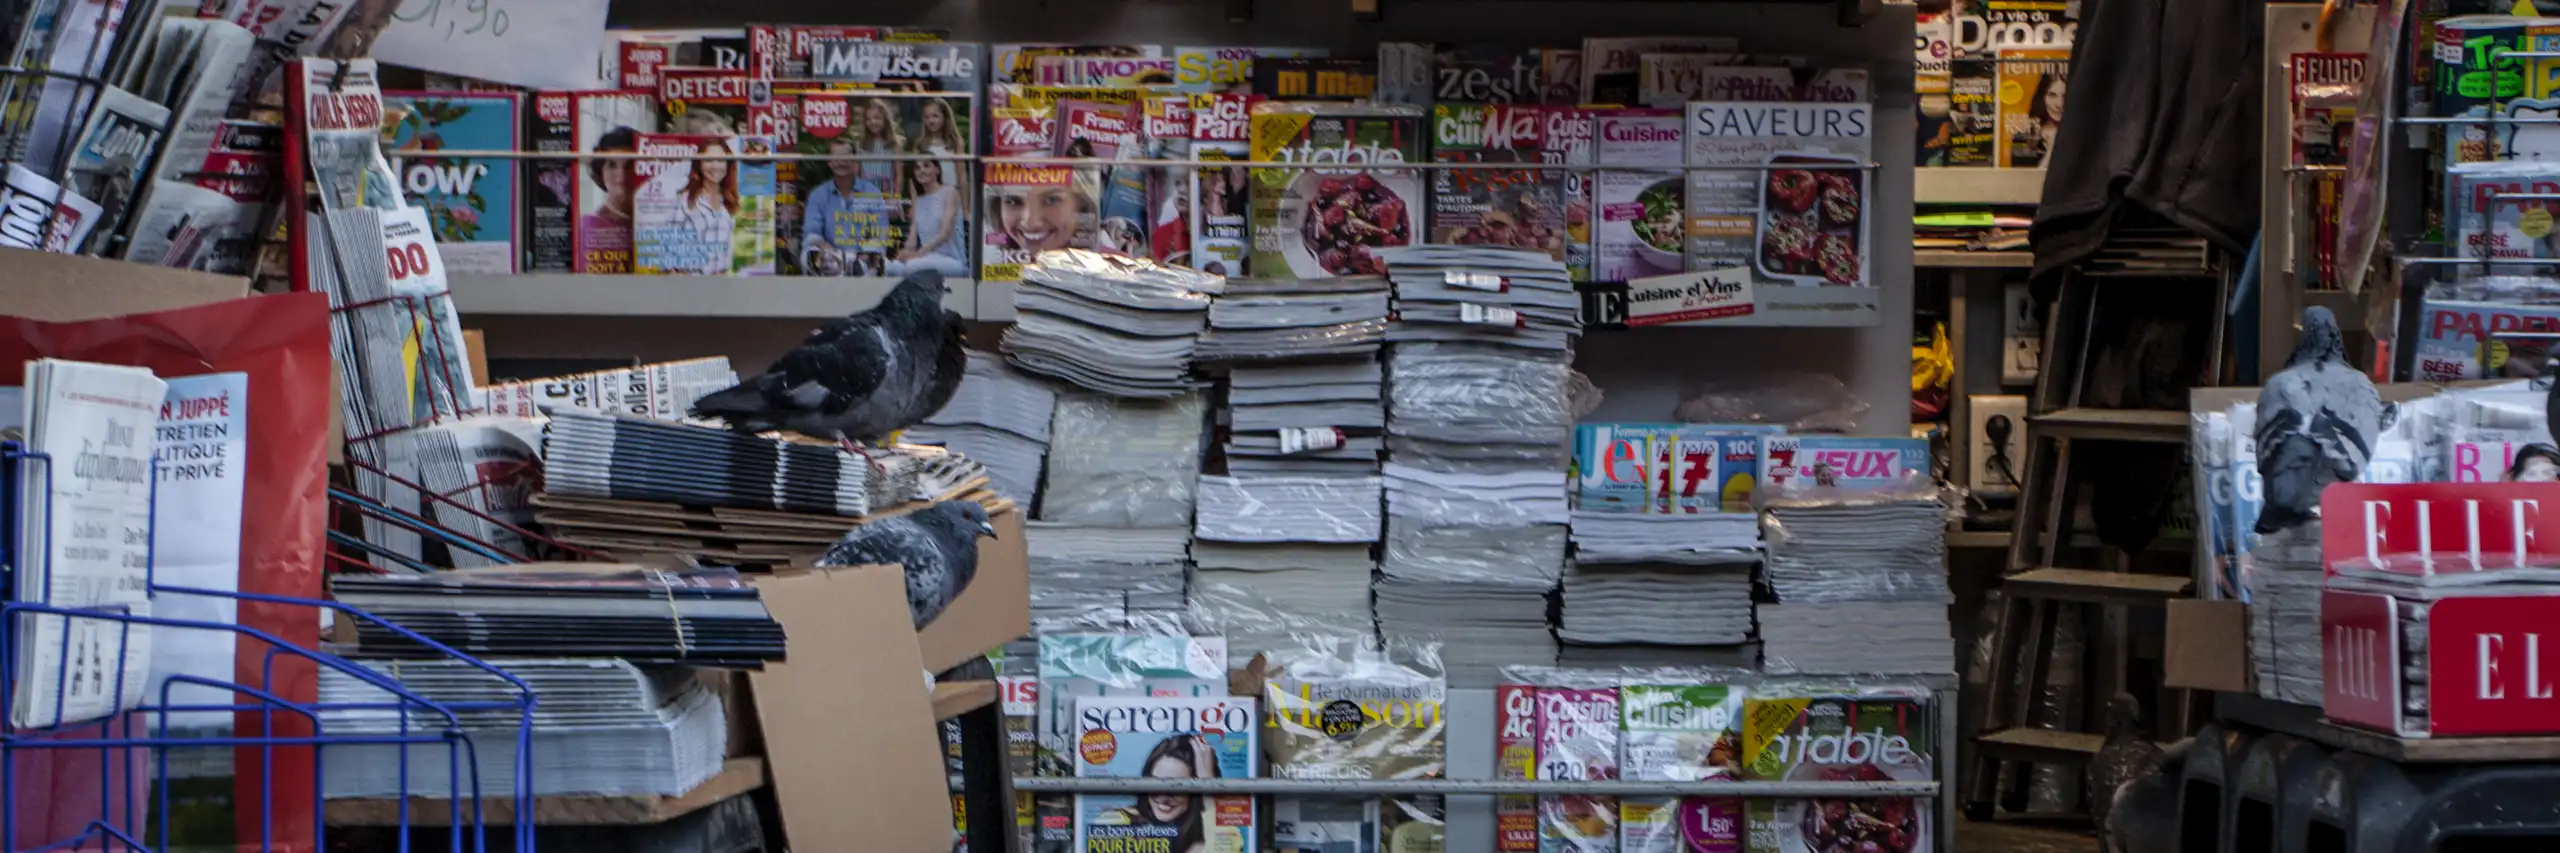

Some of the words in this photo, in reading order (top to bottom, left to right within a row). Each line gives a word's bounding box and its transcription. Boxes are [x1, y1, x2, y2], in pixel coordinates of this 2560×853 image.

[2031, 11, 2049, 21] du
[805, 101, 848, 115] POINT
[823, 116, 848, 127] VUE
[1603, 120, 1681, 142] Cuisine
[1698, 108, 1865, 137] SAVEURS
[1702, 276, 1742, 296] Vins
[176, 390, 230, 420] JUPPÉ
[175, 462, 226, 480] PRIVÉ
[1801, 450, 1898, 478] JEUX
[1336, 683, 1398, 702] journal
[1265, 683, 1440, 729] Mson
[1082, 702, 1249, 745] serengo
[1088, 826, 1104, 837] Les
[1107, 826, 1134, 837] bons
[1088, 839, 1123, 853] POUR
